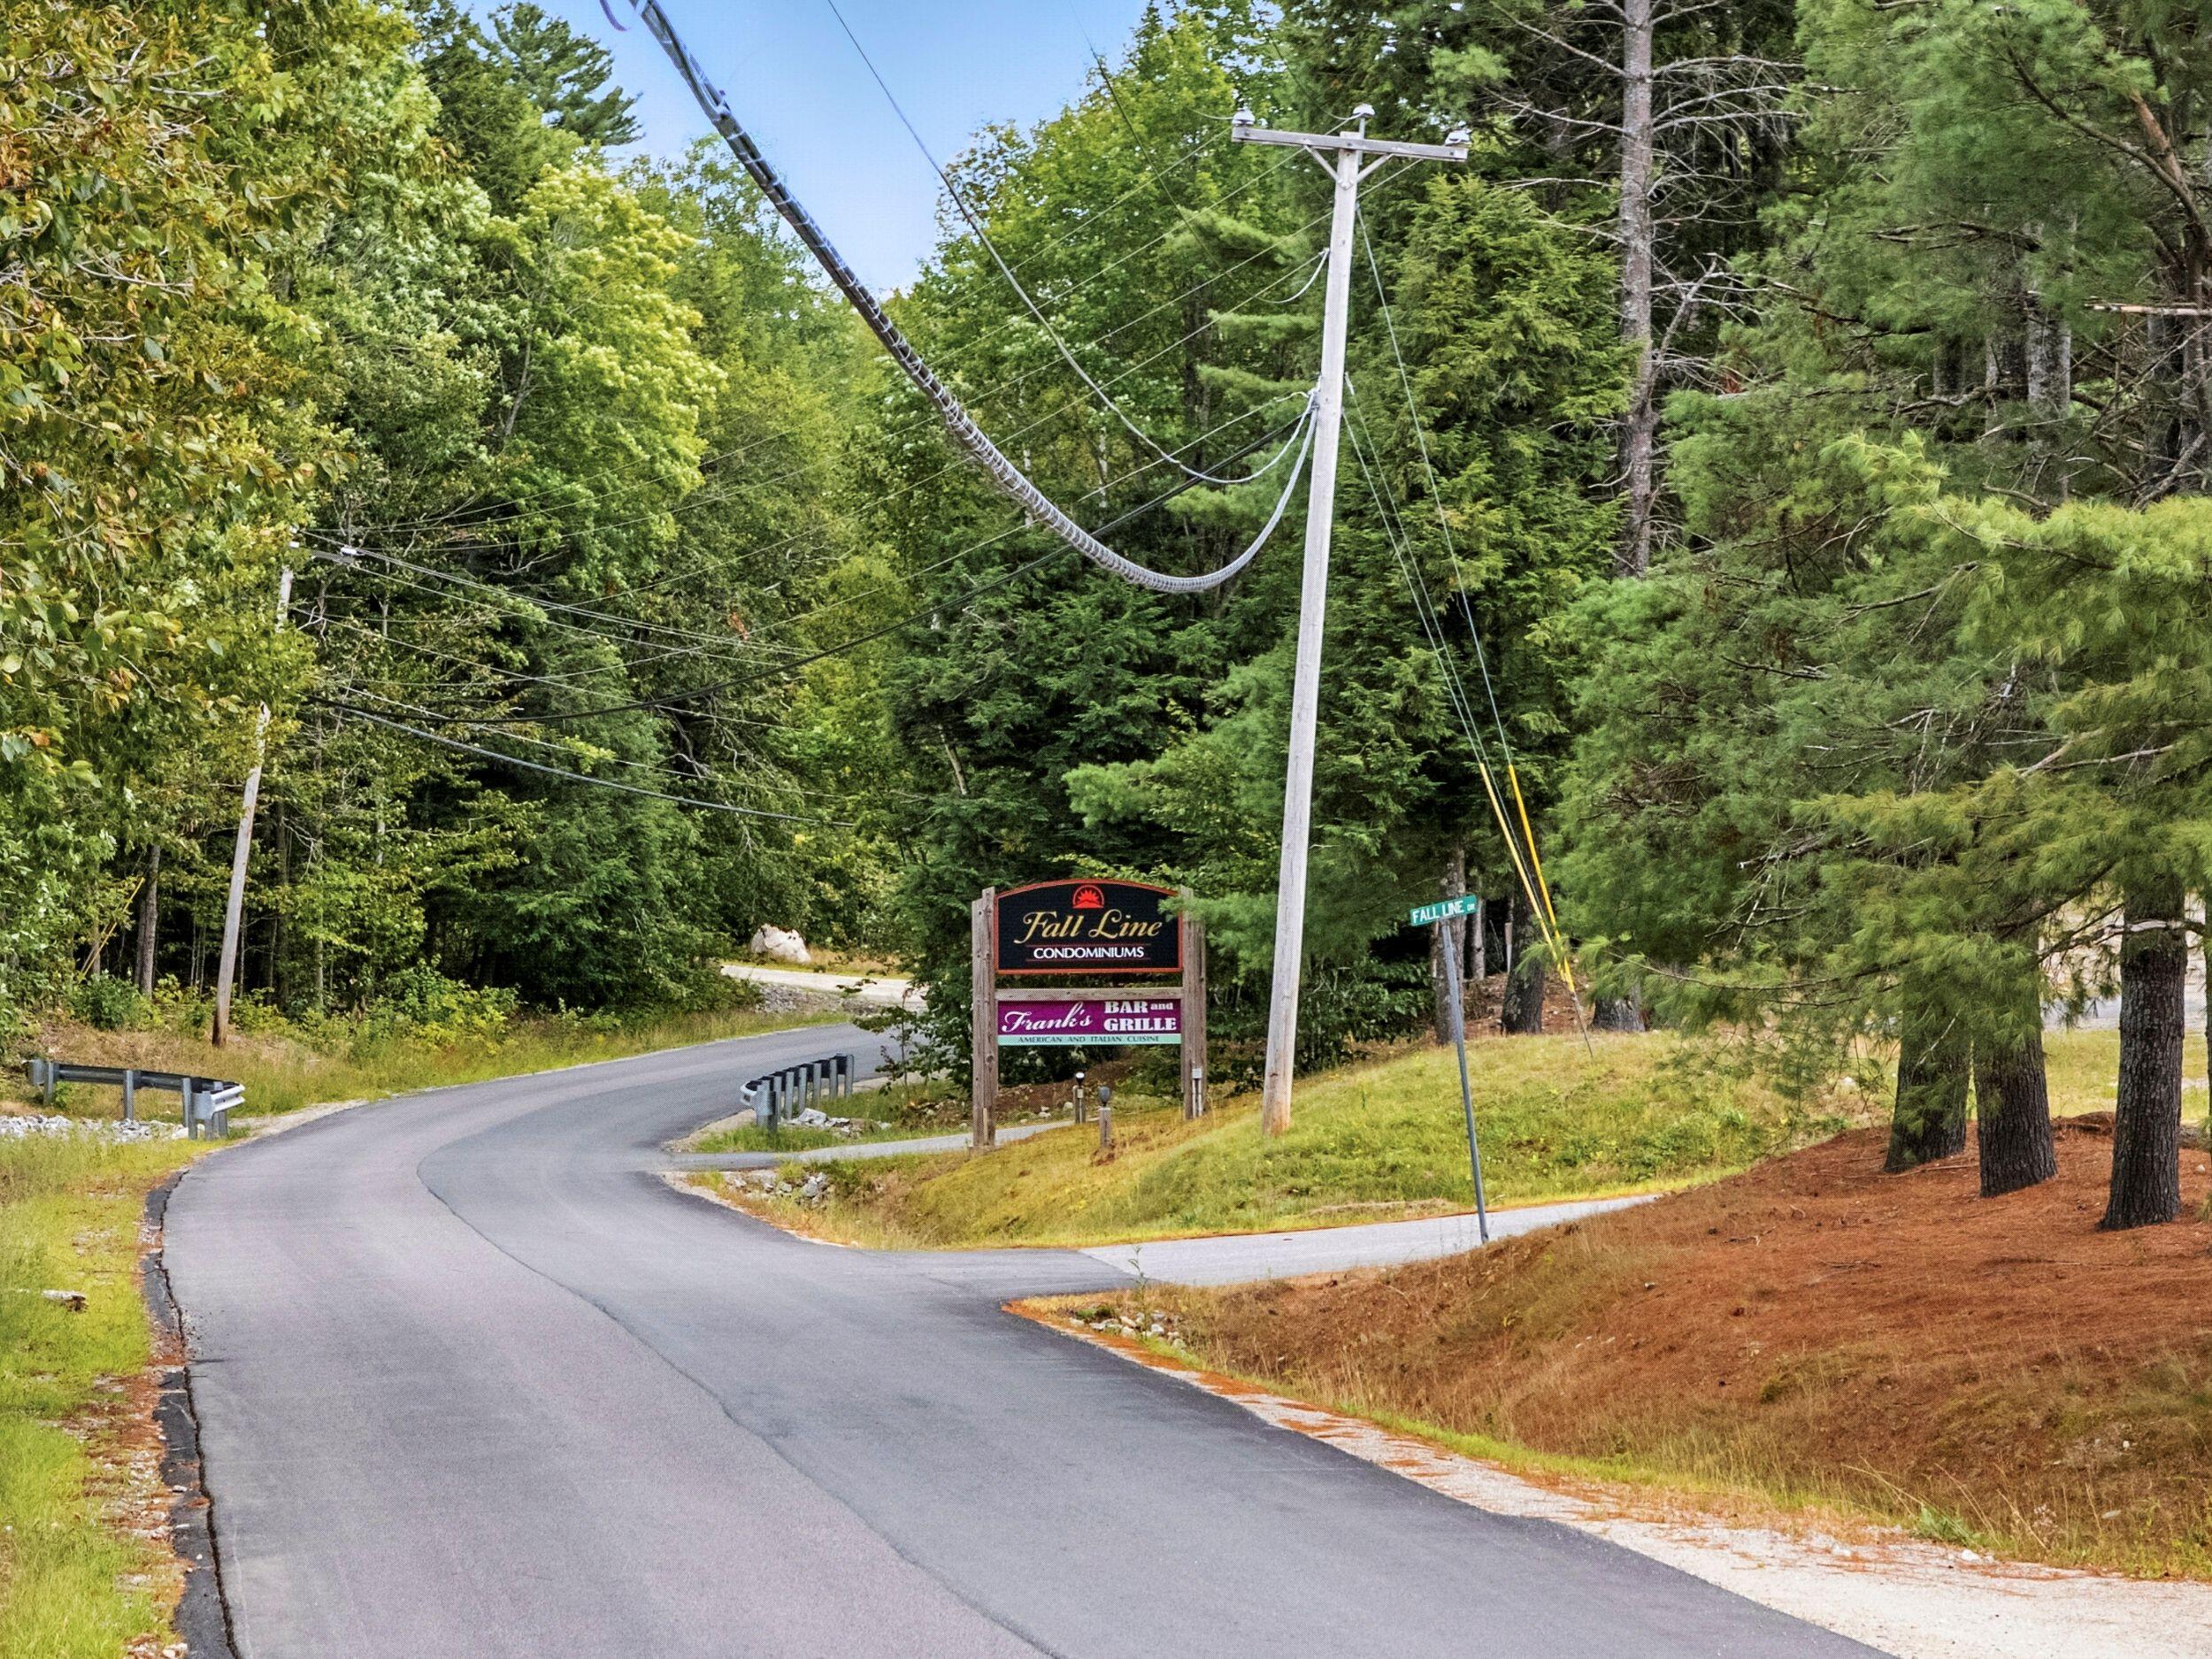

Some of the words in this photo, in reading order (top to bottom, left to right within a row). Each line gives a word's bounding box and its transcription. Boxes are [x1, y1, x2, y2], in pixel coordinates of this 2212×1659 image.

[1412, 906, 1440, 923] FALL
[1441, 900, 1464, 917] LINE
[1014, 910, 1084, 944] Fall
[1088, 909, 1163, 939] Line
[1033, 947, 1145, 959] CONDOMINIUMS
[1104, 1001, 1148, 1014] BAR
[1002, 1002, 1093, 1033] Frank's
[1103, 1018, 1177, 1032] GRILLE
